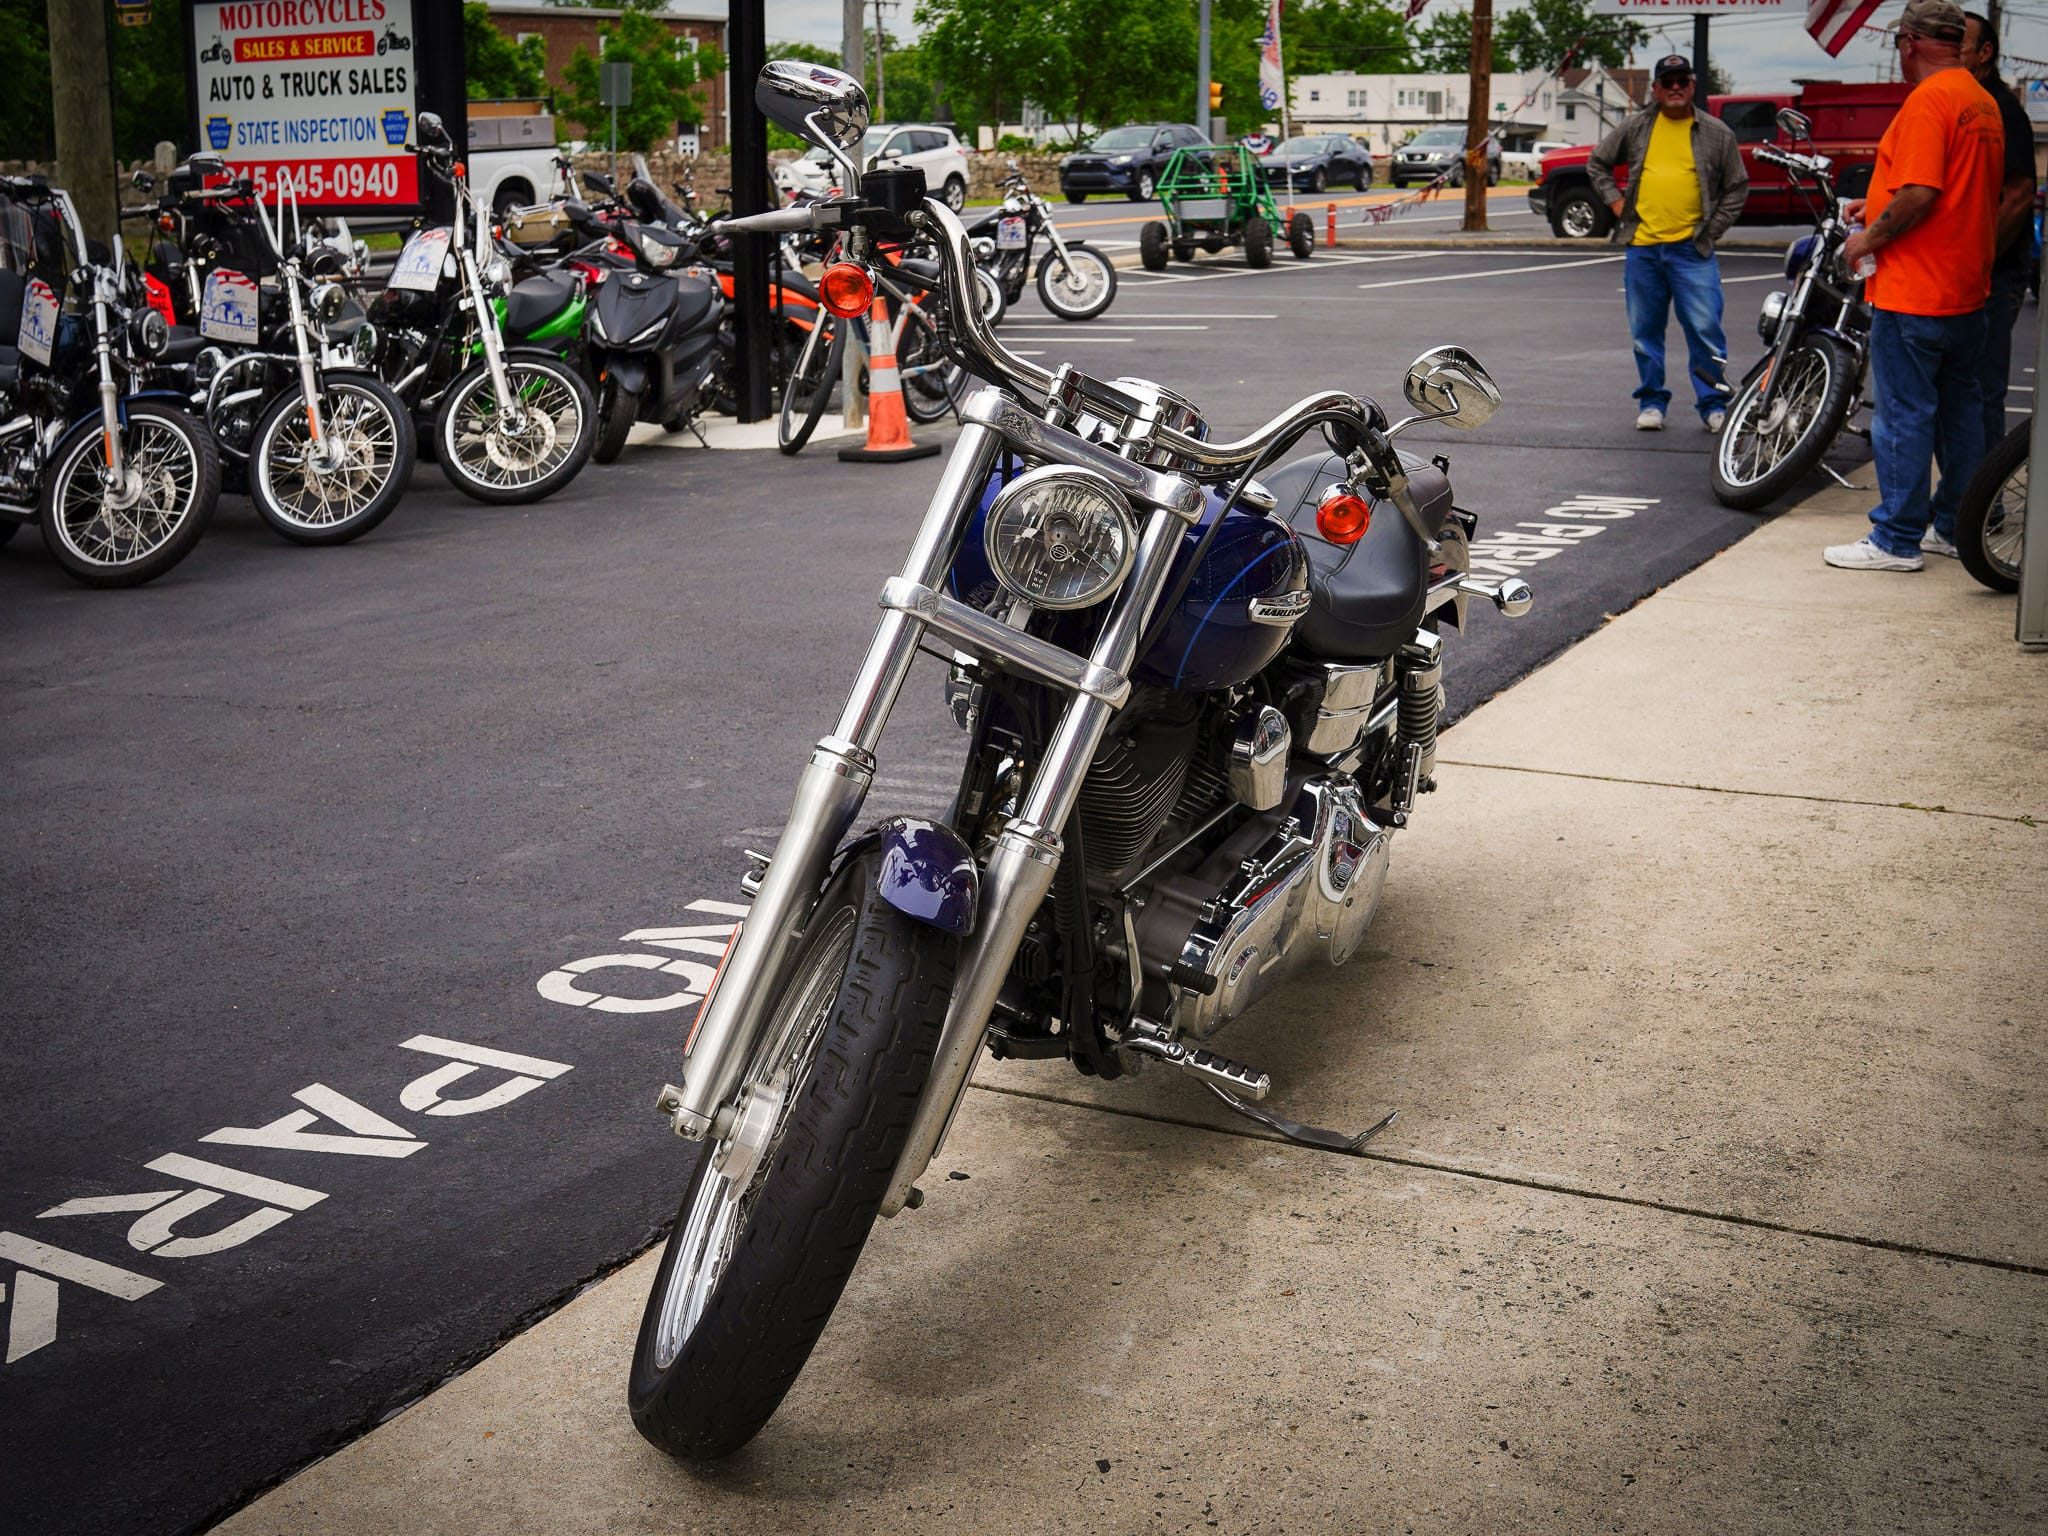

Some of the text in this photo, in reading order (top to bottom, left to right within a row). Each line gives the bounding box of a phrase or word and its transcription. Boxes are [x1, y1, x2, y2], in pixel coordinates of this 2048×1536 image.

[219, 0, 386, 31] MOTORCYCLES
[242, 35, 366, 58] SALES & SERVICE
[209, 66, 407, 101] AUTO & TRUCK SALES
[237, 119, 280, 145] STATE
[284, 116, 377, 144] INSPECTION
[1544, 495, 1661, 520] NO
[536, 898, 751, 1014] NO
